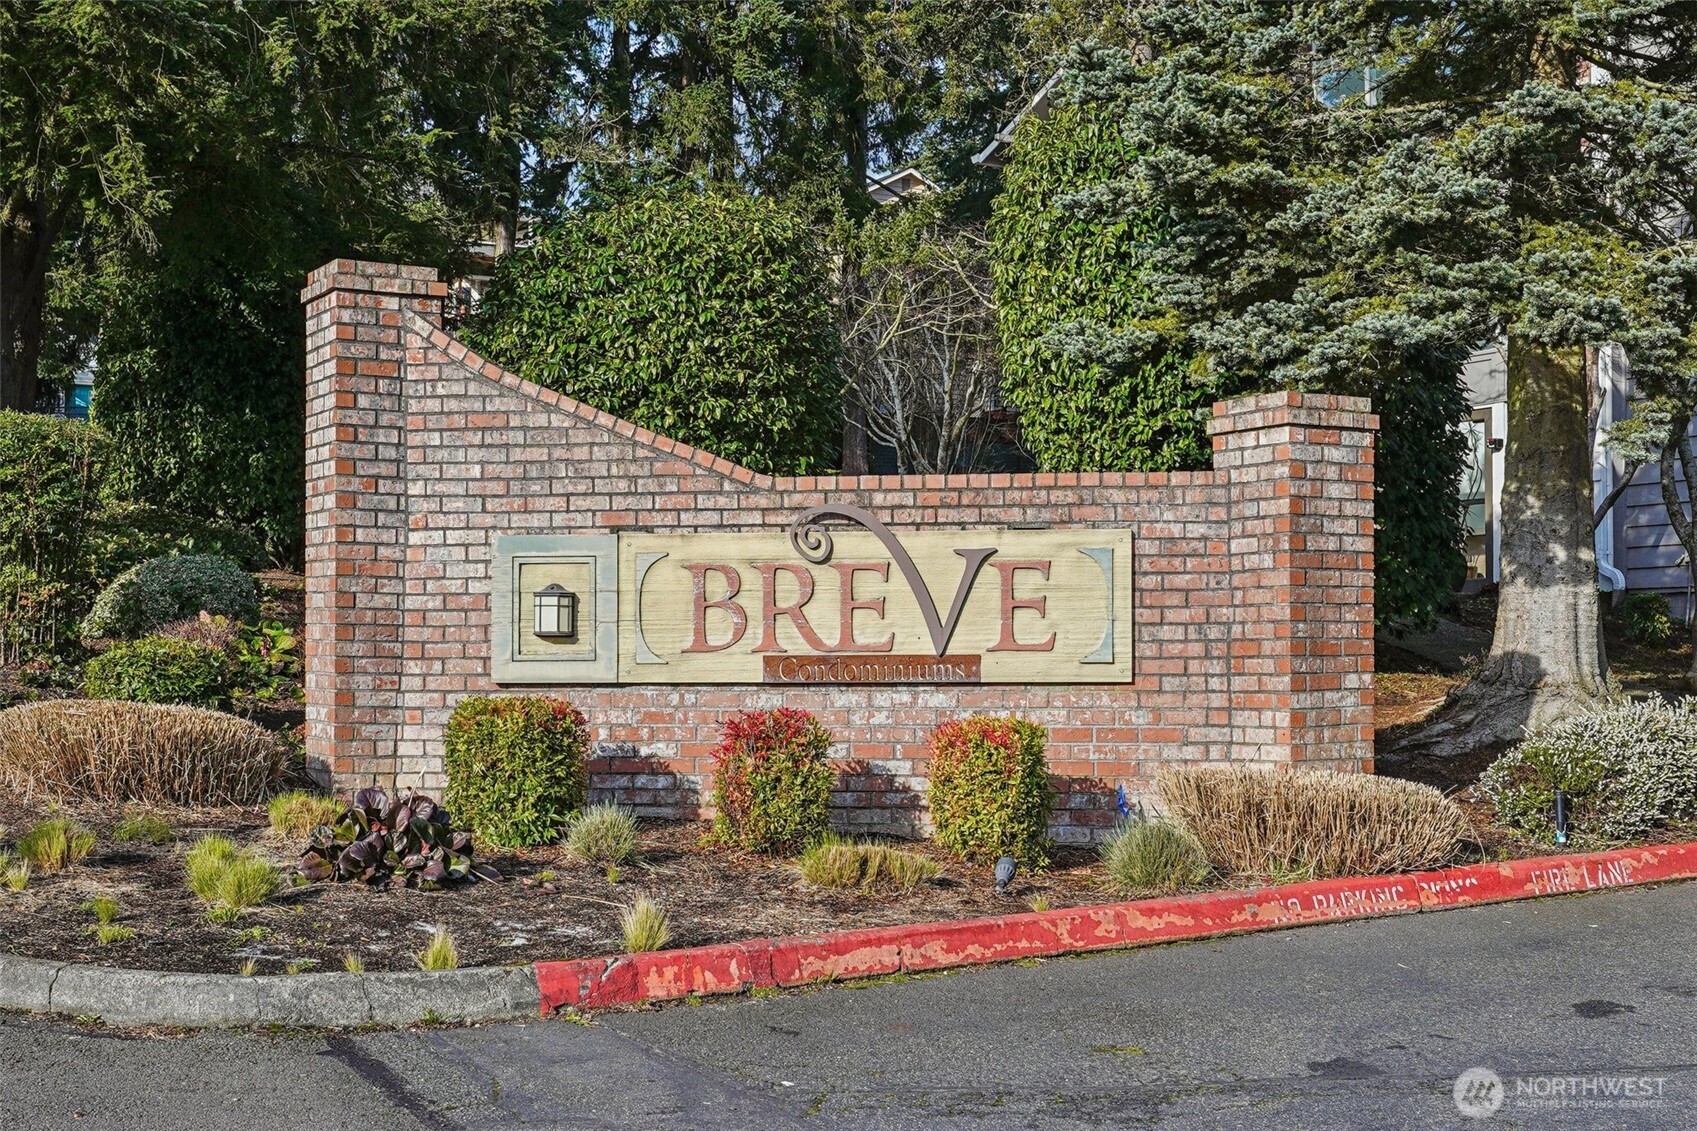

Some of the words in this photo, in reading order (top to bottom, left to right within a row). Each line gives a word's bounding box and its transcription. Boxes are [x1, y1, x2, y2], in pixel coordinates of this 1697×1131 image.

[681, 504, 1057, 657] BREVE
[779, 656, 966, 682] Condominiums
[1583, 859, 1634, 888] LANE
